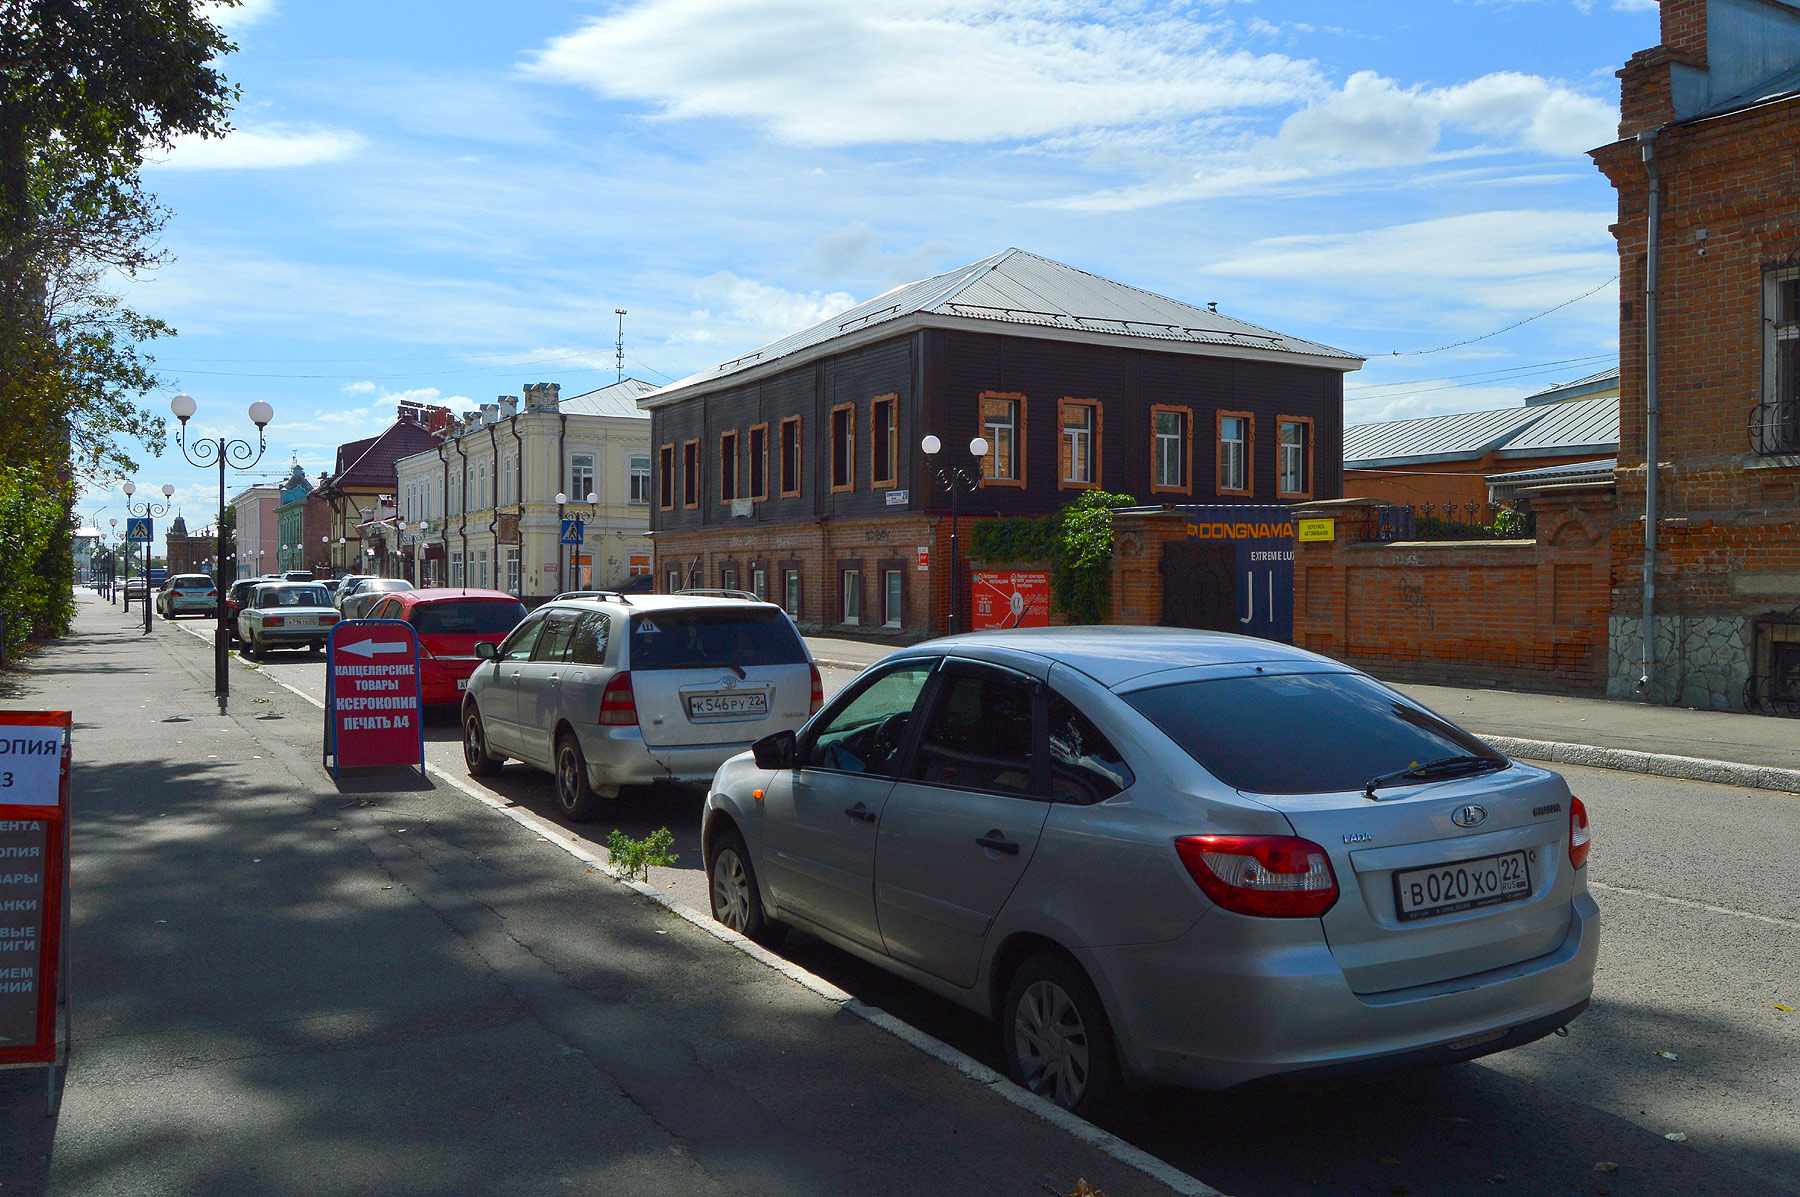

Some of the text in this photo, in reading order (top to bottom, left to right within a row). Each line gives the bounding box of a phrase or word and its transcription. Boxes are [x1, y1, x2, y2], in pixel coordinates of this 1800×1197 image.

[1199, 523, 1295, 539] DONGNAMA
[1251, 551, 1282, 561] EXTREME
[335, 664, 415, 677] КАНЦЕЛЯРСКИЕ
[355, 680, 399, 691] ТОВАРЫ
[336, 696, 417, 711] КСЕРОКОПИЯ
[343, 715, 410, 731] ПЕЧАТЬ А4
[0, 771, 14, 788] 3
[1342, 832, 1372, 844] LADA
[1501, 857, 1521, 881] 22
[0, 873, 39, 884] АРЫ
[1502, 880, 1517, 890] RUS
[0, 899, 37, 911] НКИ
[0, 940, 36, 952] ИГИ
